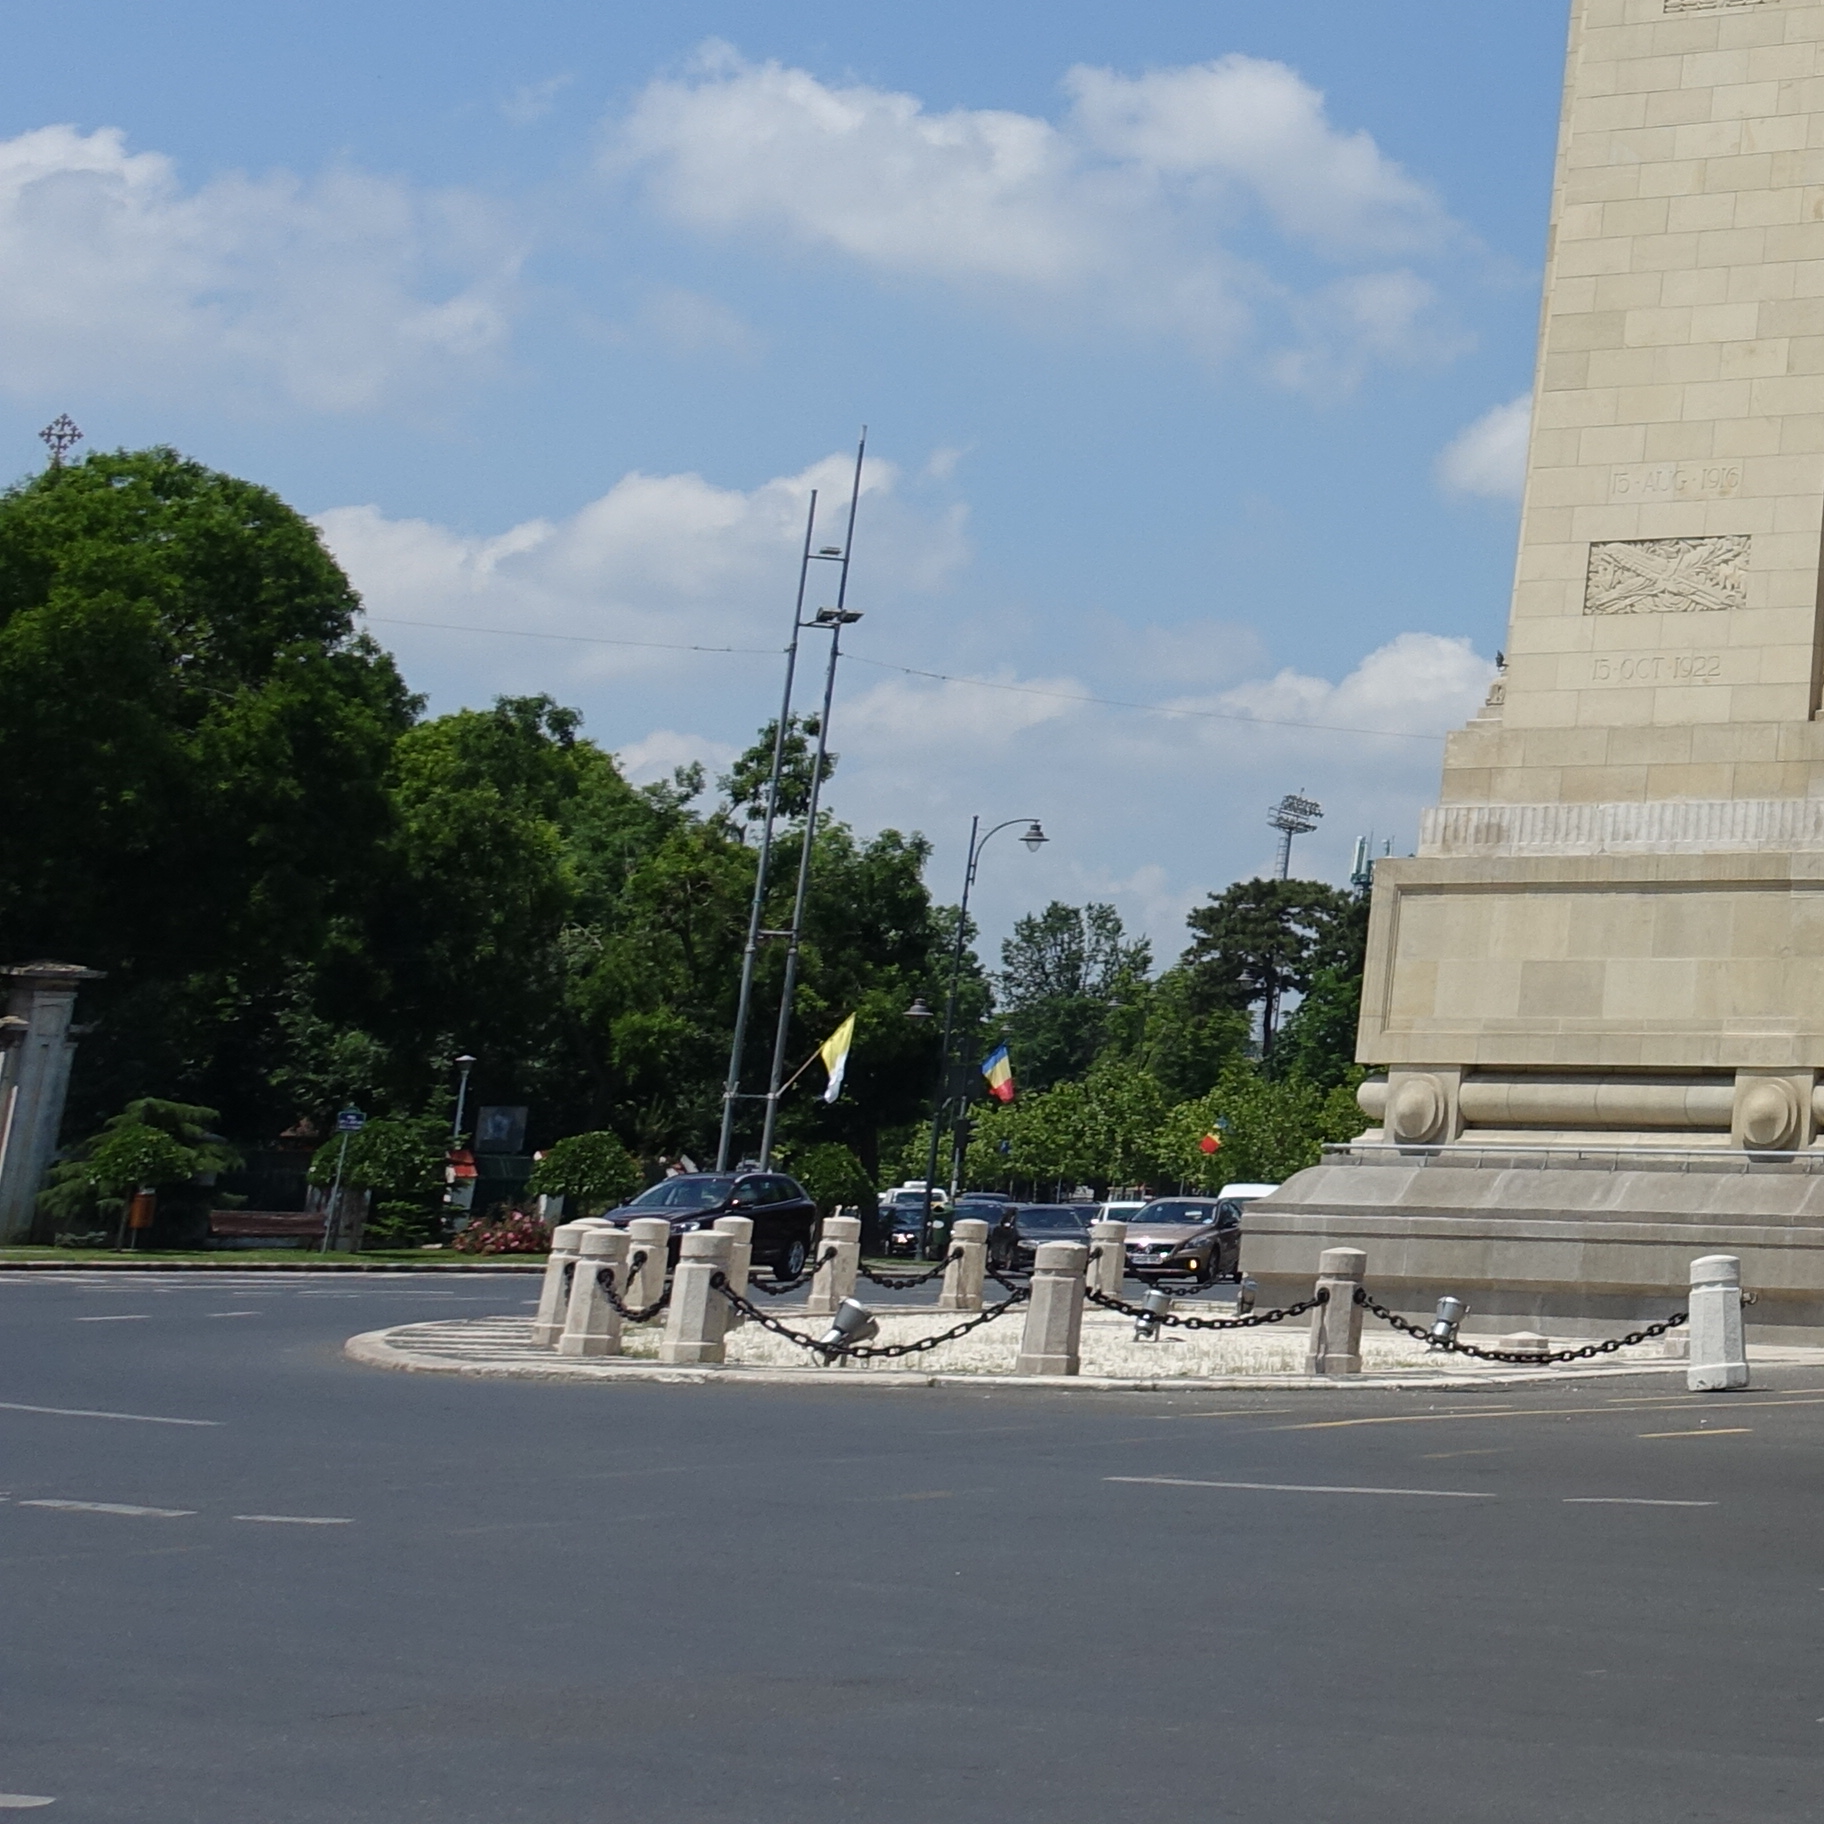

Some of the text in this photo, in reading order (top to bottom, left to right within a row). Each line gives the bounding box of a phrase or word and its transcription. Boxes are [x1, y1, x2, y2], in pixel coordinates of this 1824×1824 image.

[1611, 467, 1740, 495] 15 AUG 1916
[1592, 655, 1722, 682] 15 OCT 1922
